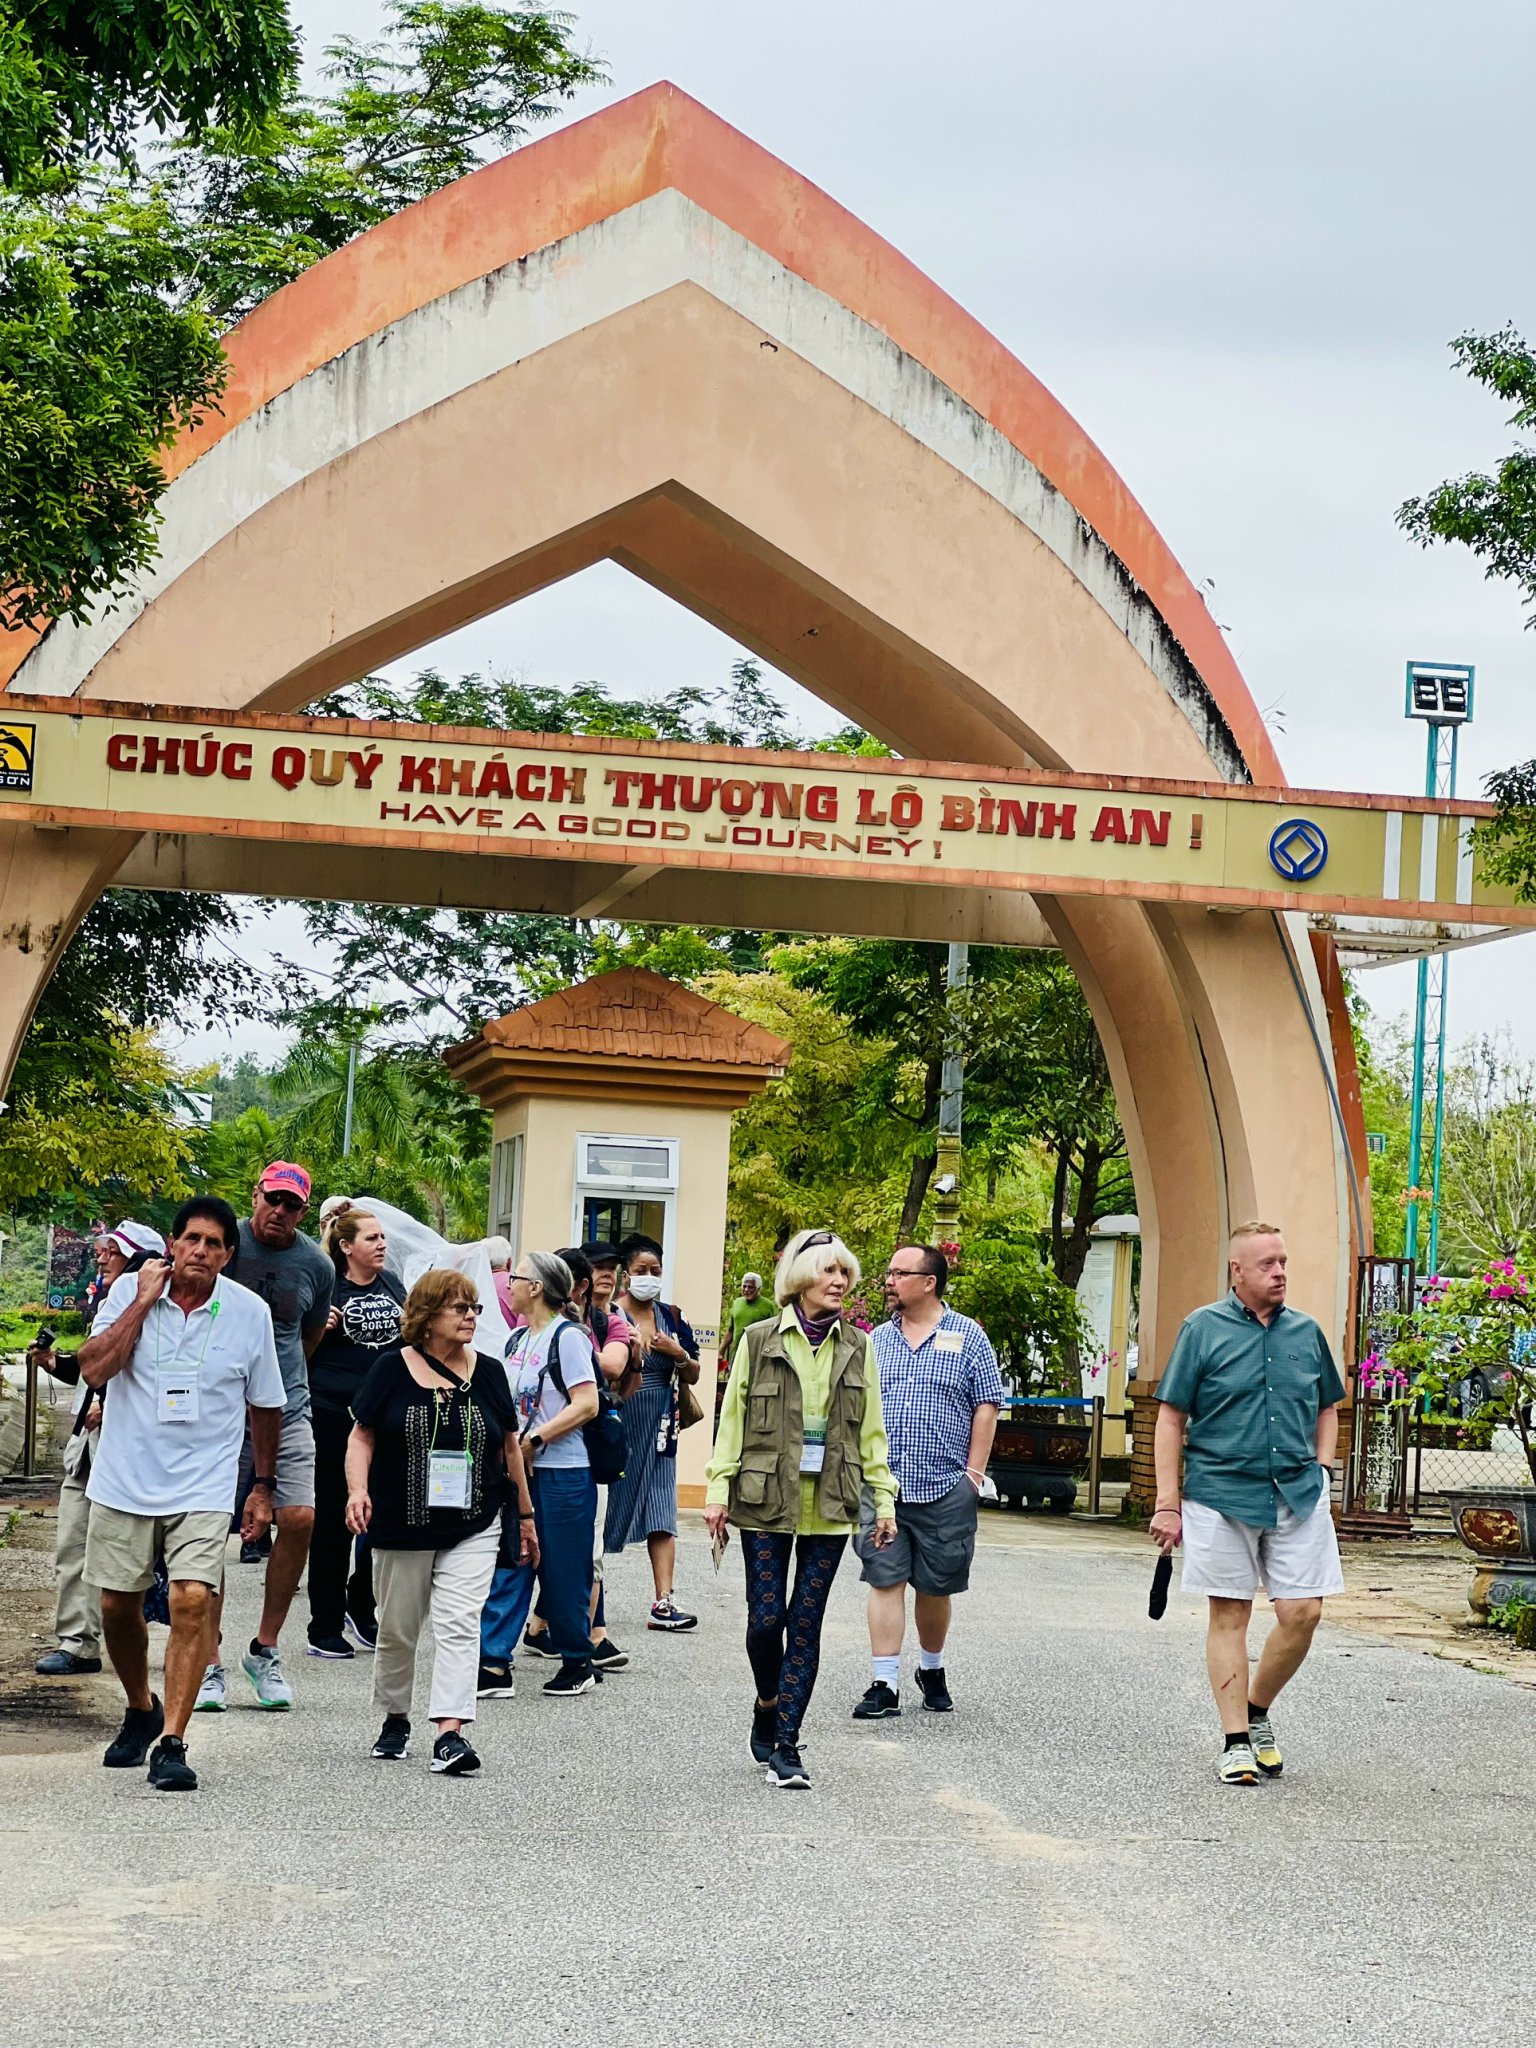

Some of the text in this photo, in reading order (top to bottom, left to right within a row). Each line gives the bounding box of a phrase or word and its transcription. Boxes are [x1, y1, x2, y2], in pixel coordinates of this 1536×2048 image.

[107, 732, 1203, 849] CHÚC QUÝ KHÁCH THƯỢNG LỘ BÌNH AN !
[380, 802, 942, 859] HAVE A GOOD JOURNEY !
[361, 1300, 392, 1309] SORTA
[346, 1306, 402, 1323] Swee
[361, 1319, 397, 1331] SORTA
